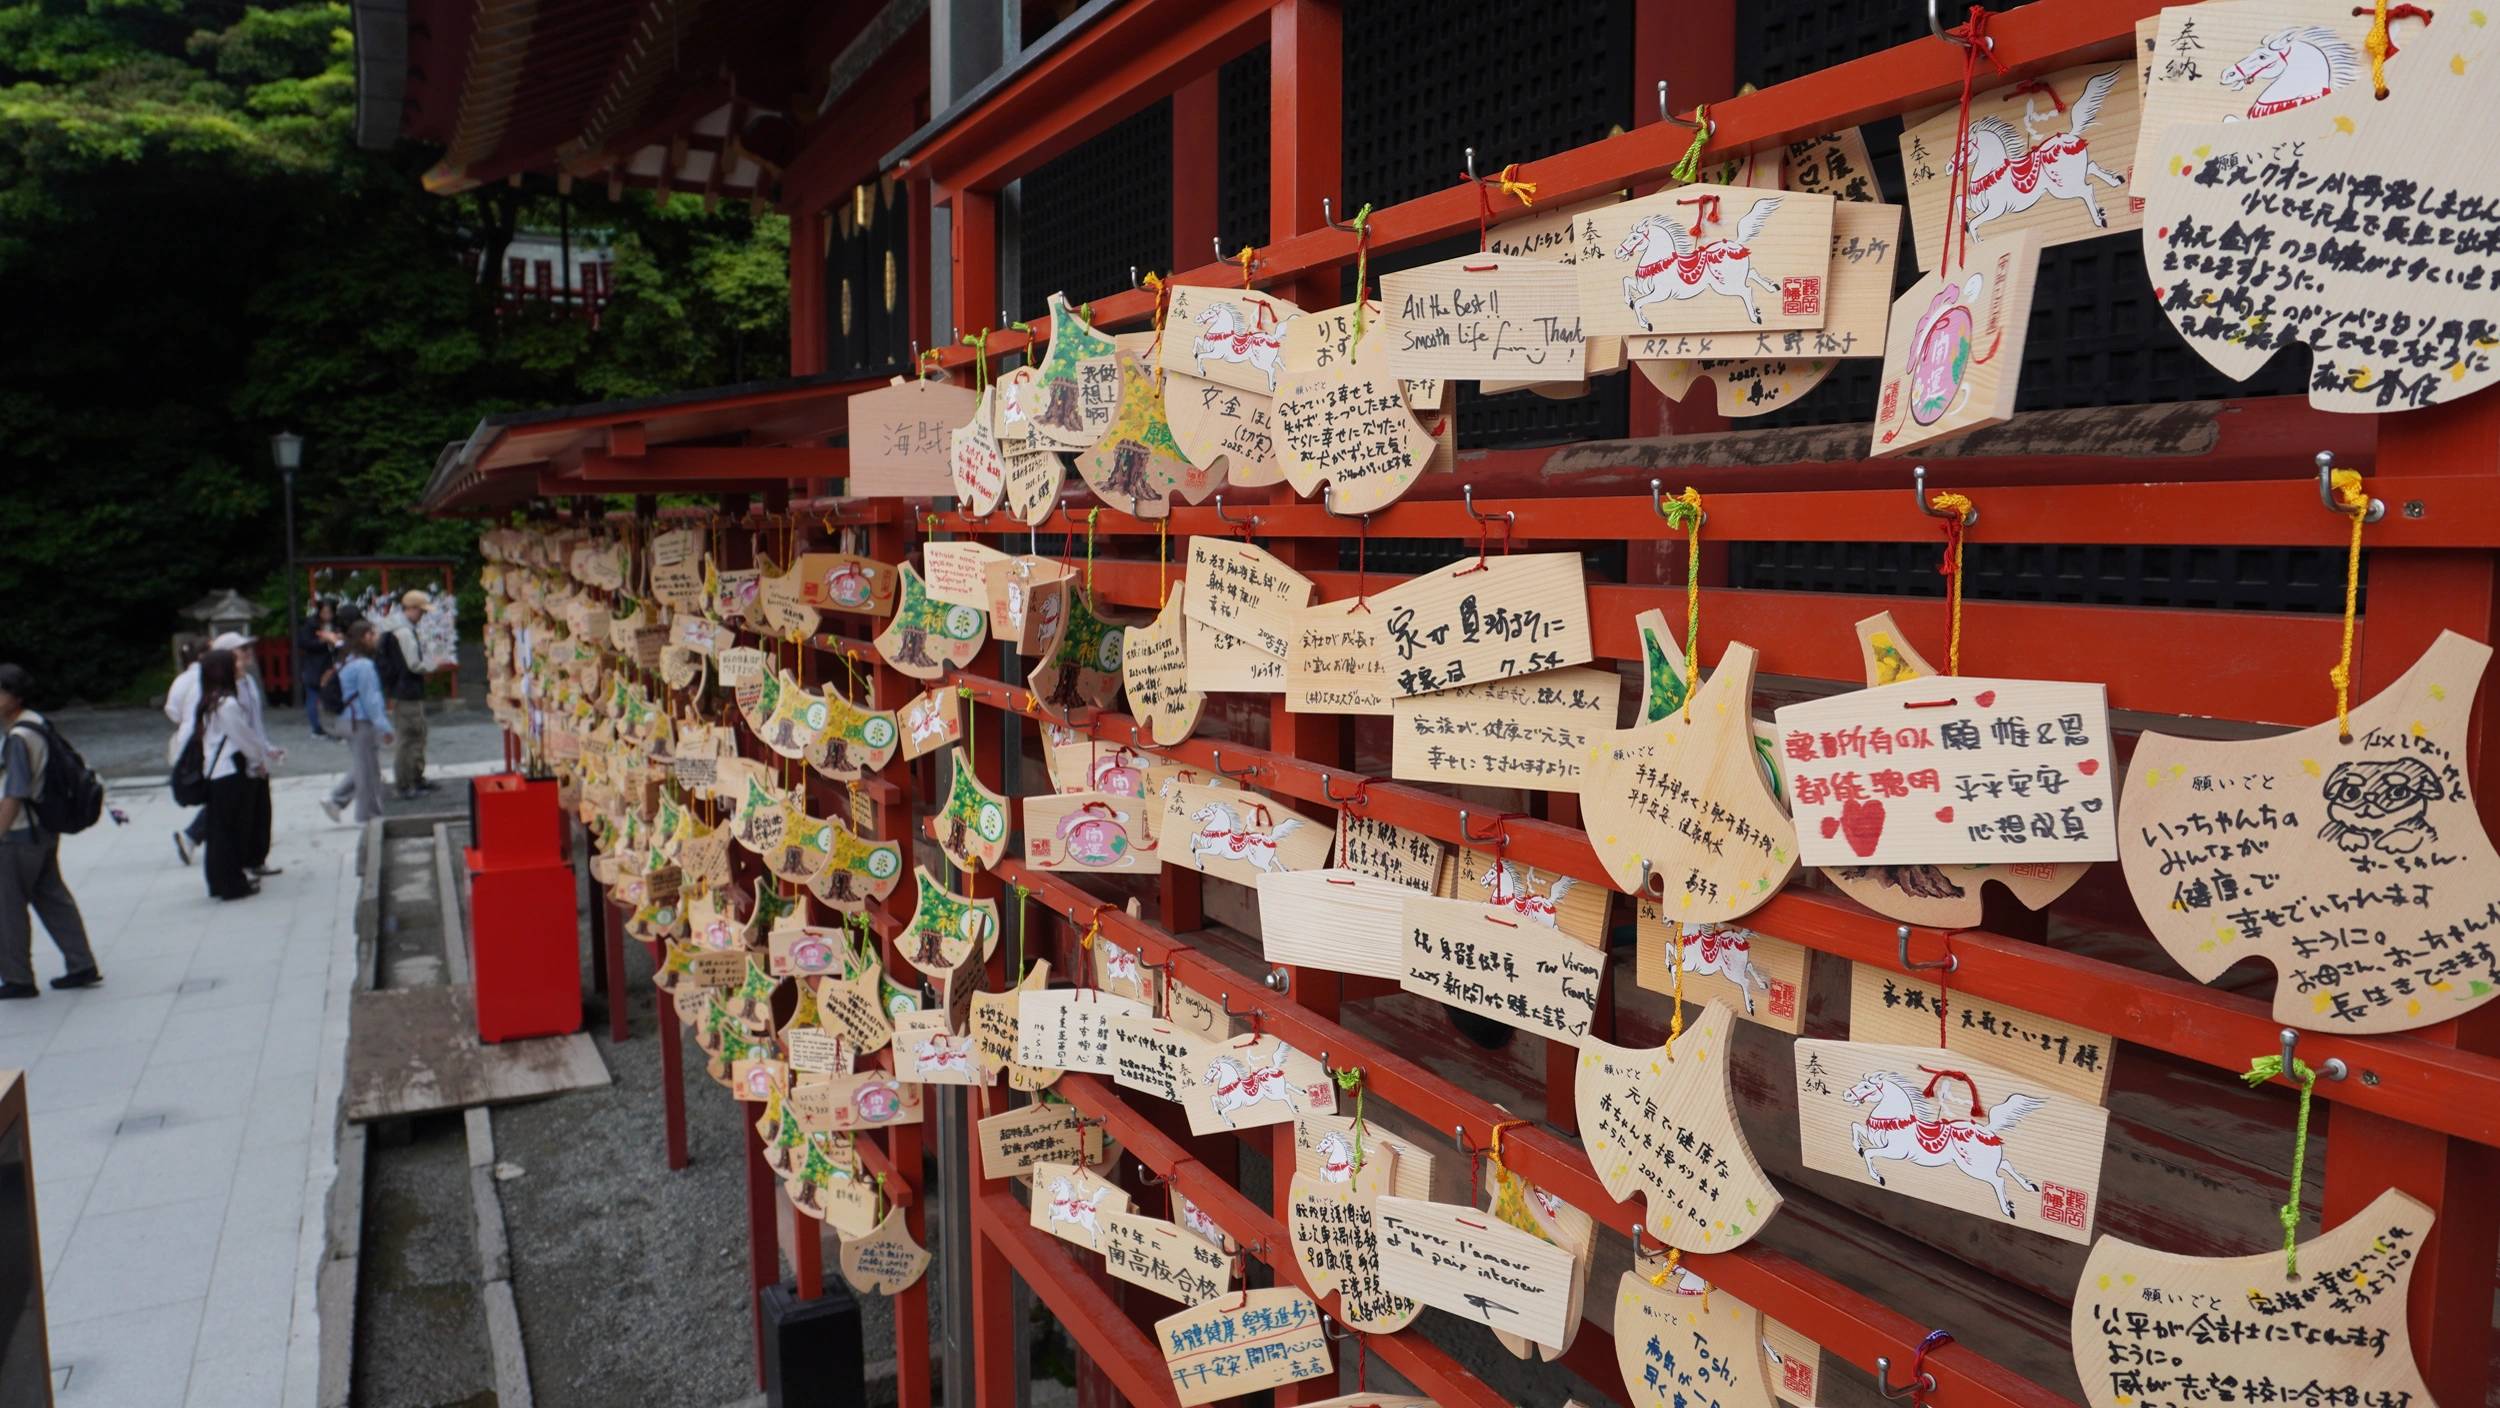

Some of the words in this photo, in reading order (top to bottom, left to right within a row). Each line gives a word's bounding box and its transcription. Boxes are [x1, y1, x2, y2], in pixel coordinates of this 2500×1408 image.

[2158, 17, 2204, 82] 奉納
[1909, 136, 1935, 185] 奉納
[1581, 218, 1605, 261] 奉納
[1170, 290, 1189, 320] 奉納
[1402, 294, 1425, 321] All
[1430, 293, 1450, 320] the
[1402, 326, 1450, 352] Smooth
[883, 420, 953, 457] 海賊
[2191, 773, 2275, 793] 願いごと
[1603, 1063, 1642, 1081] 願いごと
[1802, 1051, 1831, 1096] 奉納
[1599, 1092, 1721, 1204] 赤ちゃんを授かります
[2141, 1287, 2222, 1312] 願いごと
